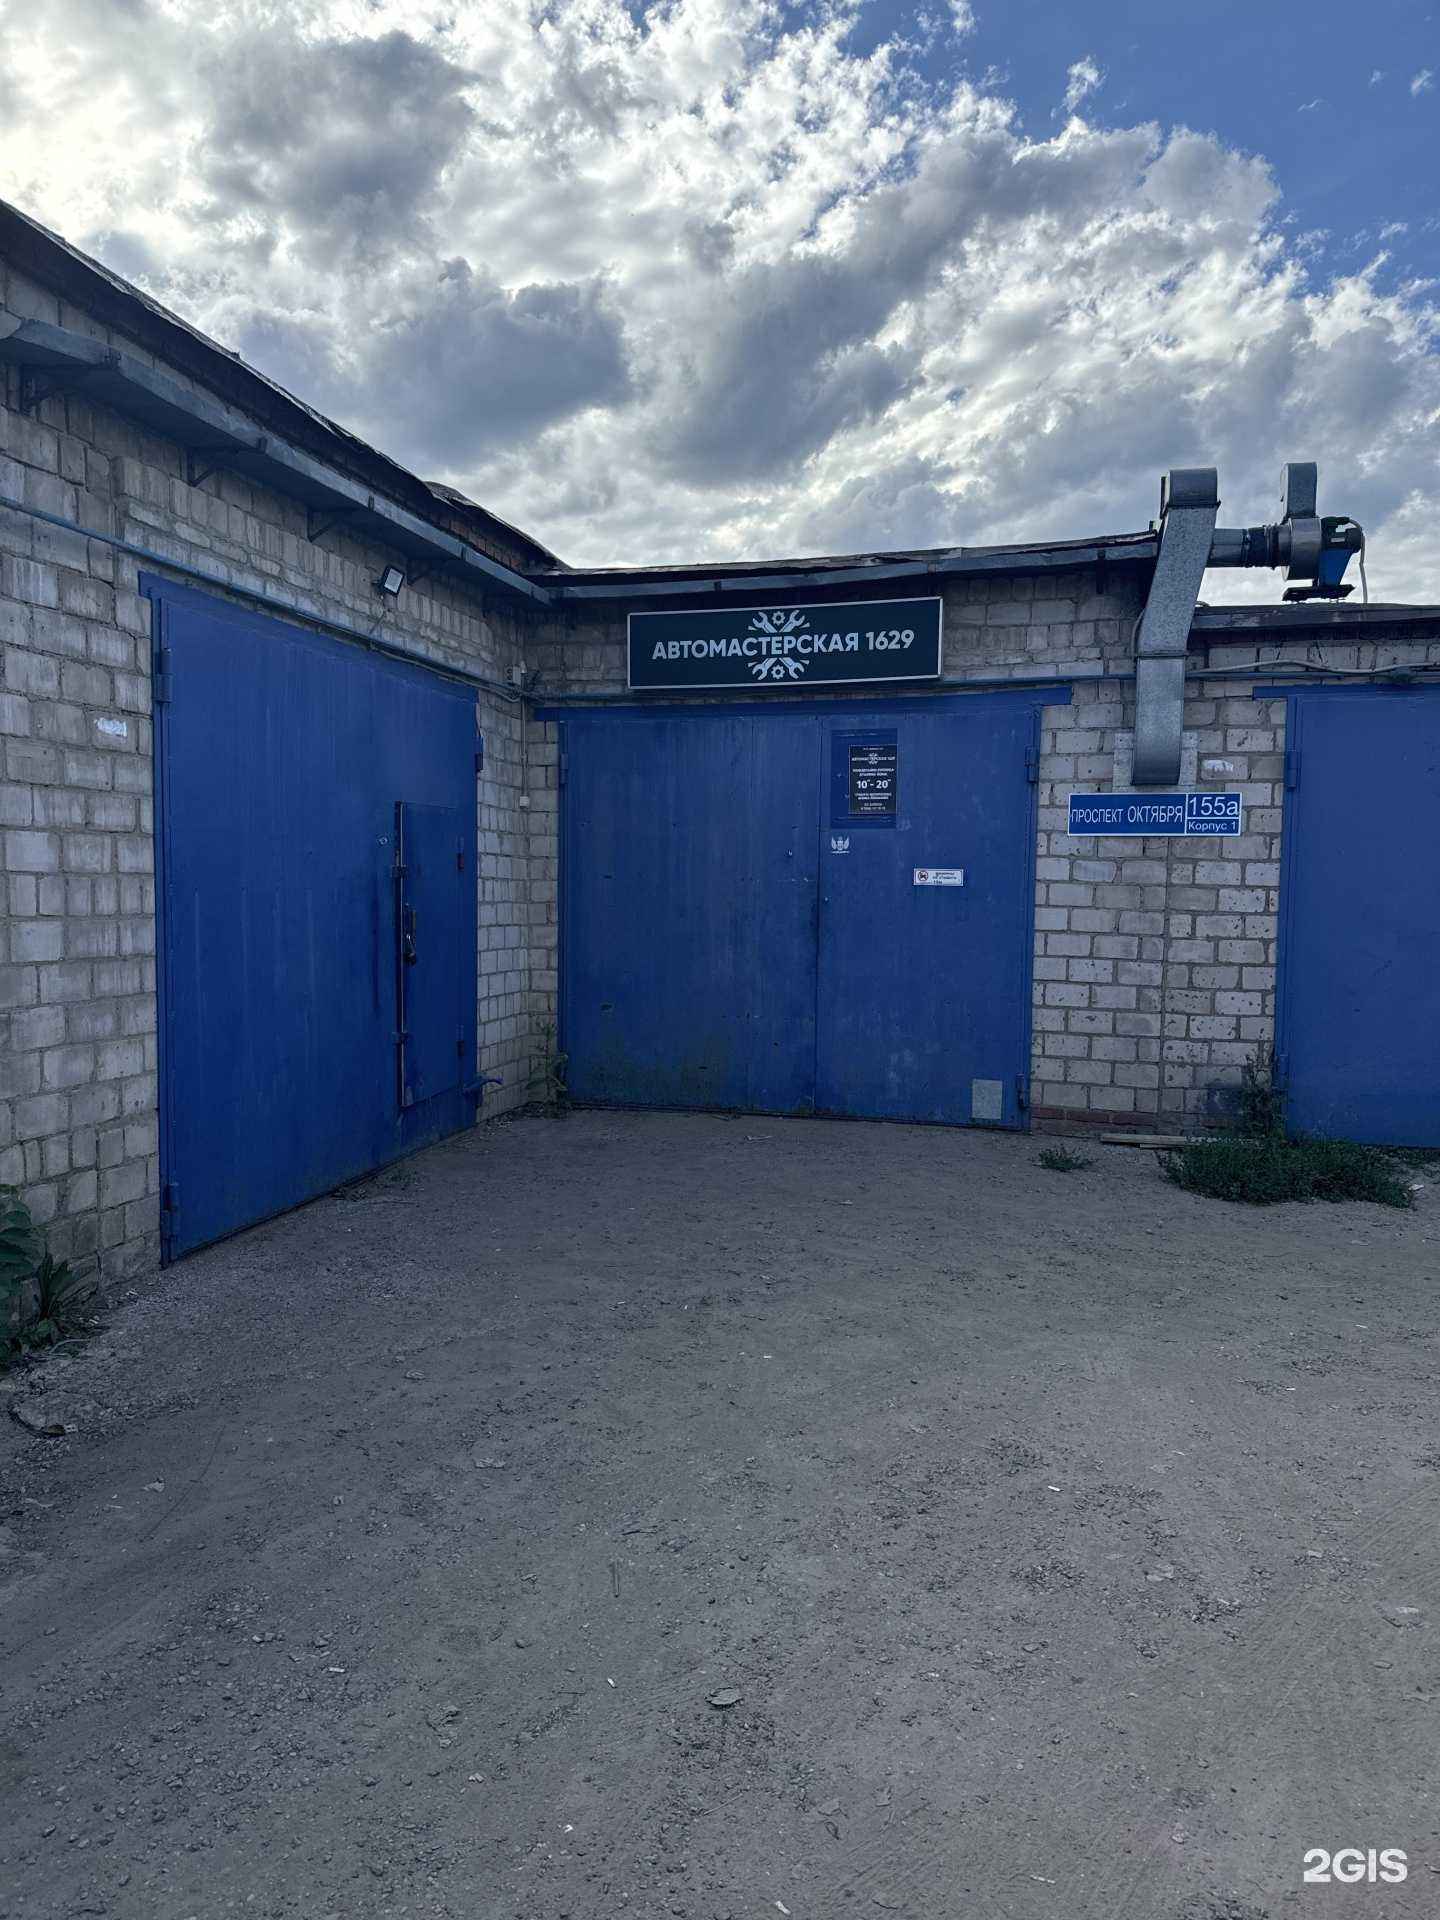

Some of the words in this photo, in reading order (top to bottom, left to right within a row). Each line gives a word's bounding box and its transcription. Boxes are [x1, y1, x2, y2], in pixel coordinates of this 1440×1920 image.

[652, 632, 858, 660] АВТОМАСТЕРСКАЯ
[865, 629, 915, 650] 1629
[1071, 808, 1123, 823] ПРОСПЕКТ
[1127, 805, 1183, 823] ОКТЯБРЯ
[1189, 796, 1239, 816] 155а
[1188, 821, 1228, 831] Корпус
[1231, 821, 1237, 830] 1
